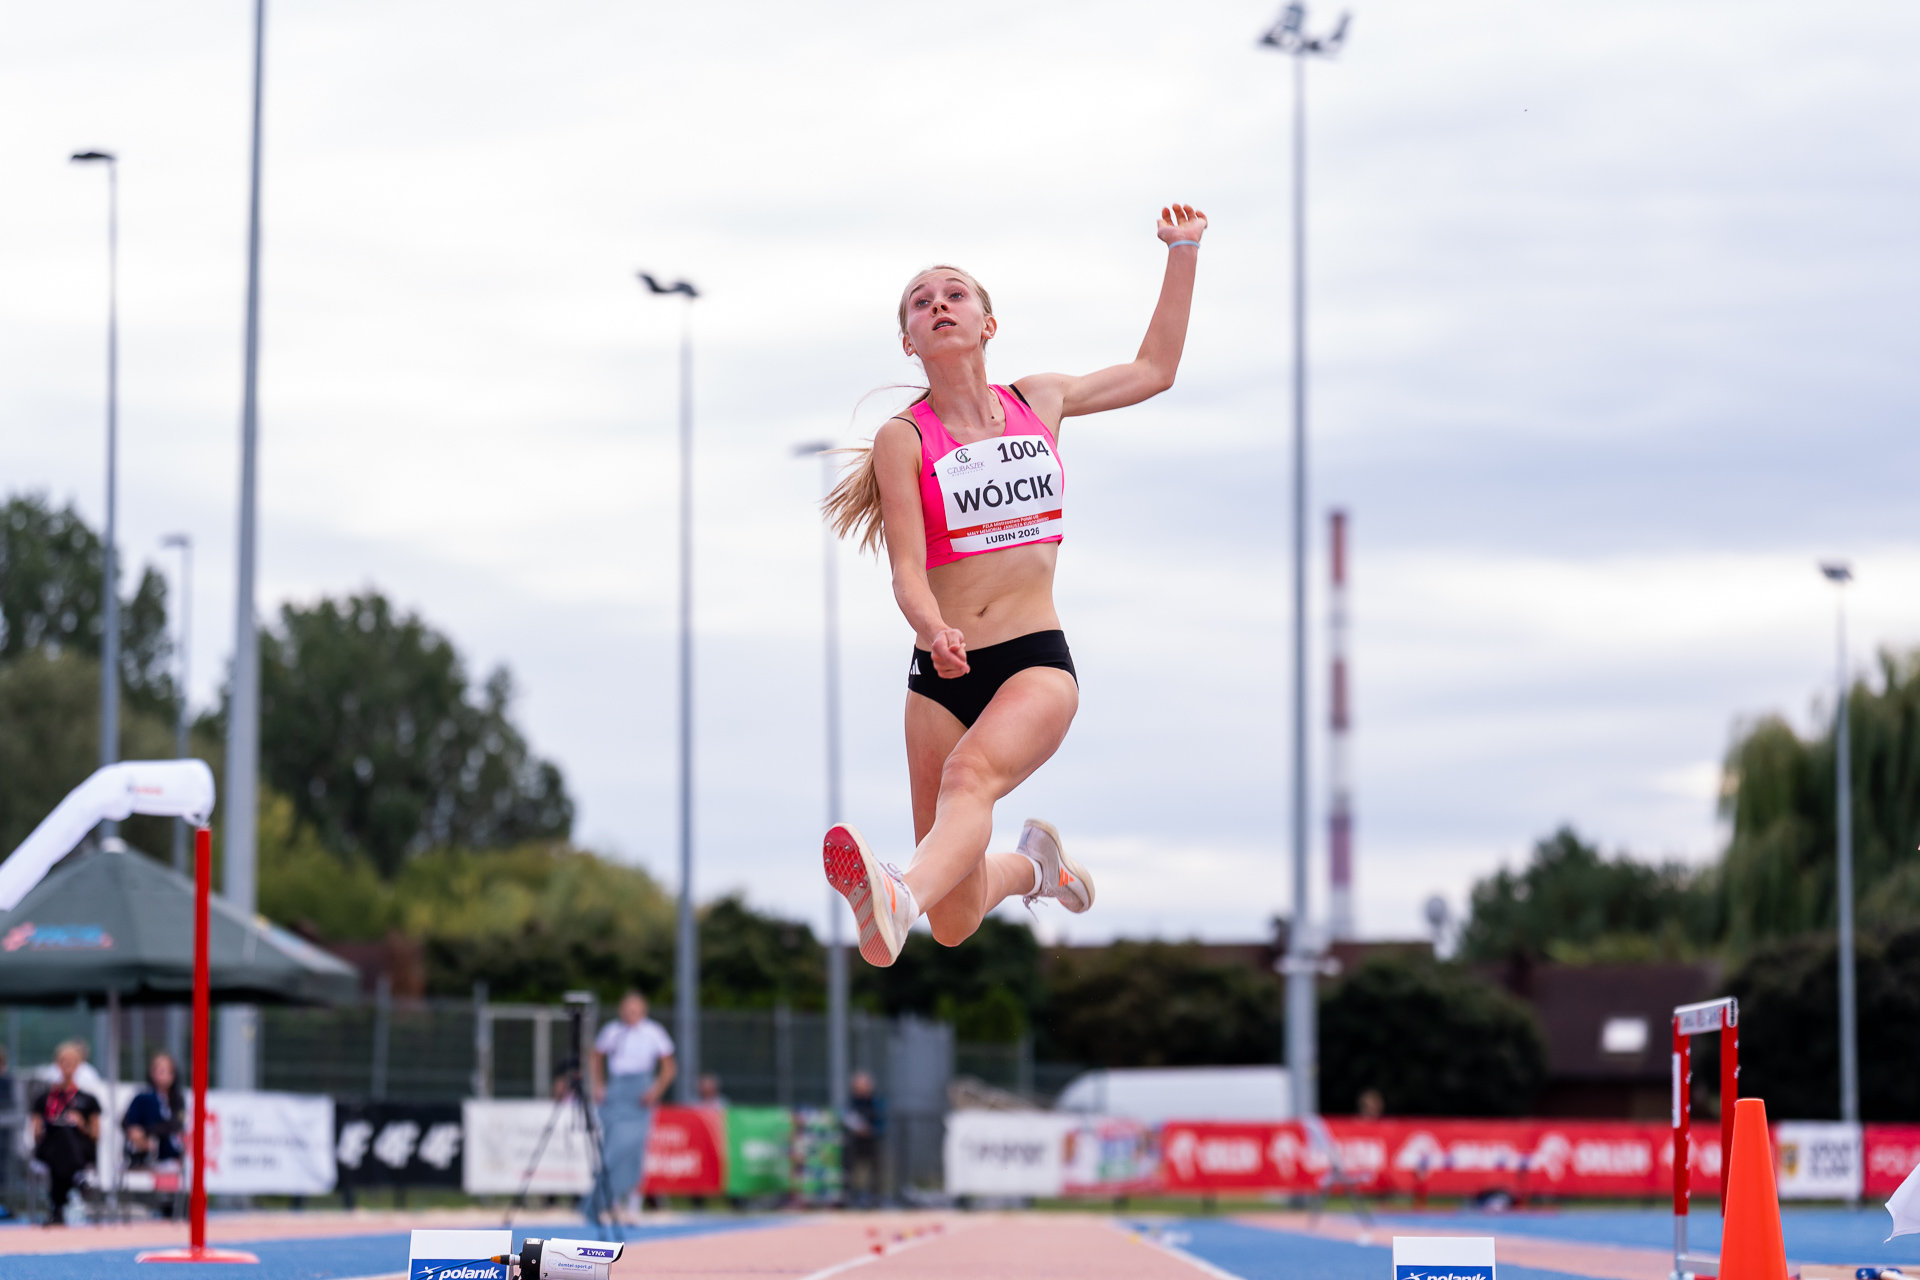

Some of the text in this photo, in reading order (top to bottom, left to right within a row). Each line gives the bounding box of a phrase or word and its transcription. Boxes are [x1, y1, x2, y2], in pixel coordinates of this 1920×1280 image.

[997, 440, 1050, 463] 1004
[947, 461, 985, 475] CZUBASZEK
[953, 473, 1054, 514] WÓJCIK
[985, 527, 1040, 545] LUBIN 2026
[586, 1249, 606, 1257] LYNX
[438, 1266, 500, 1280] polanik
